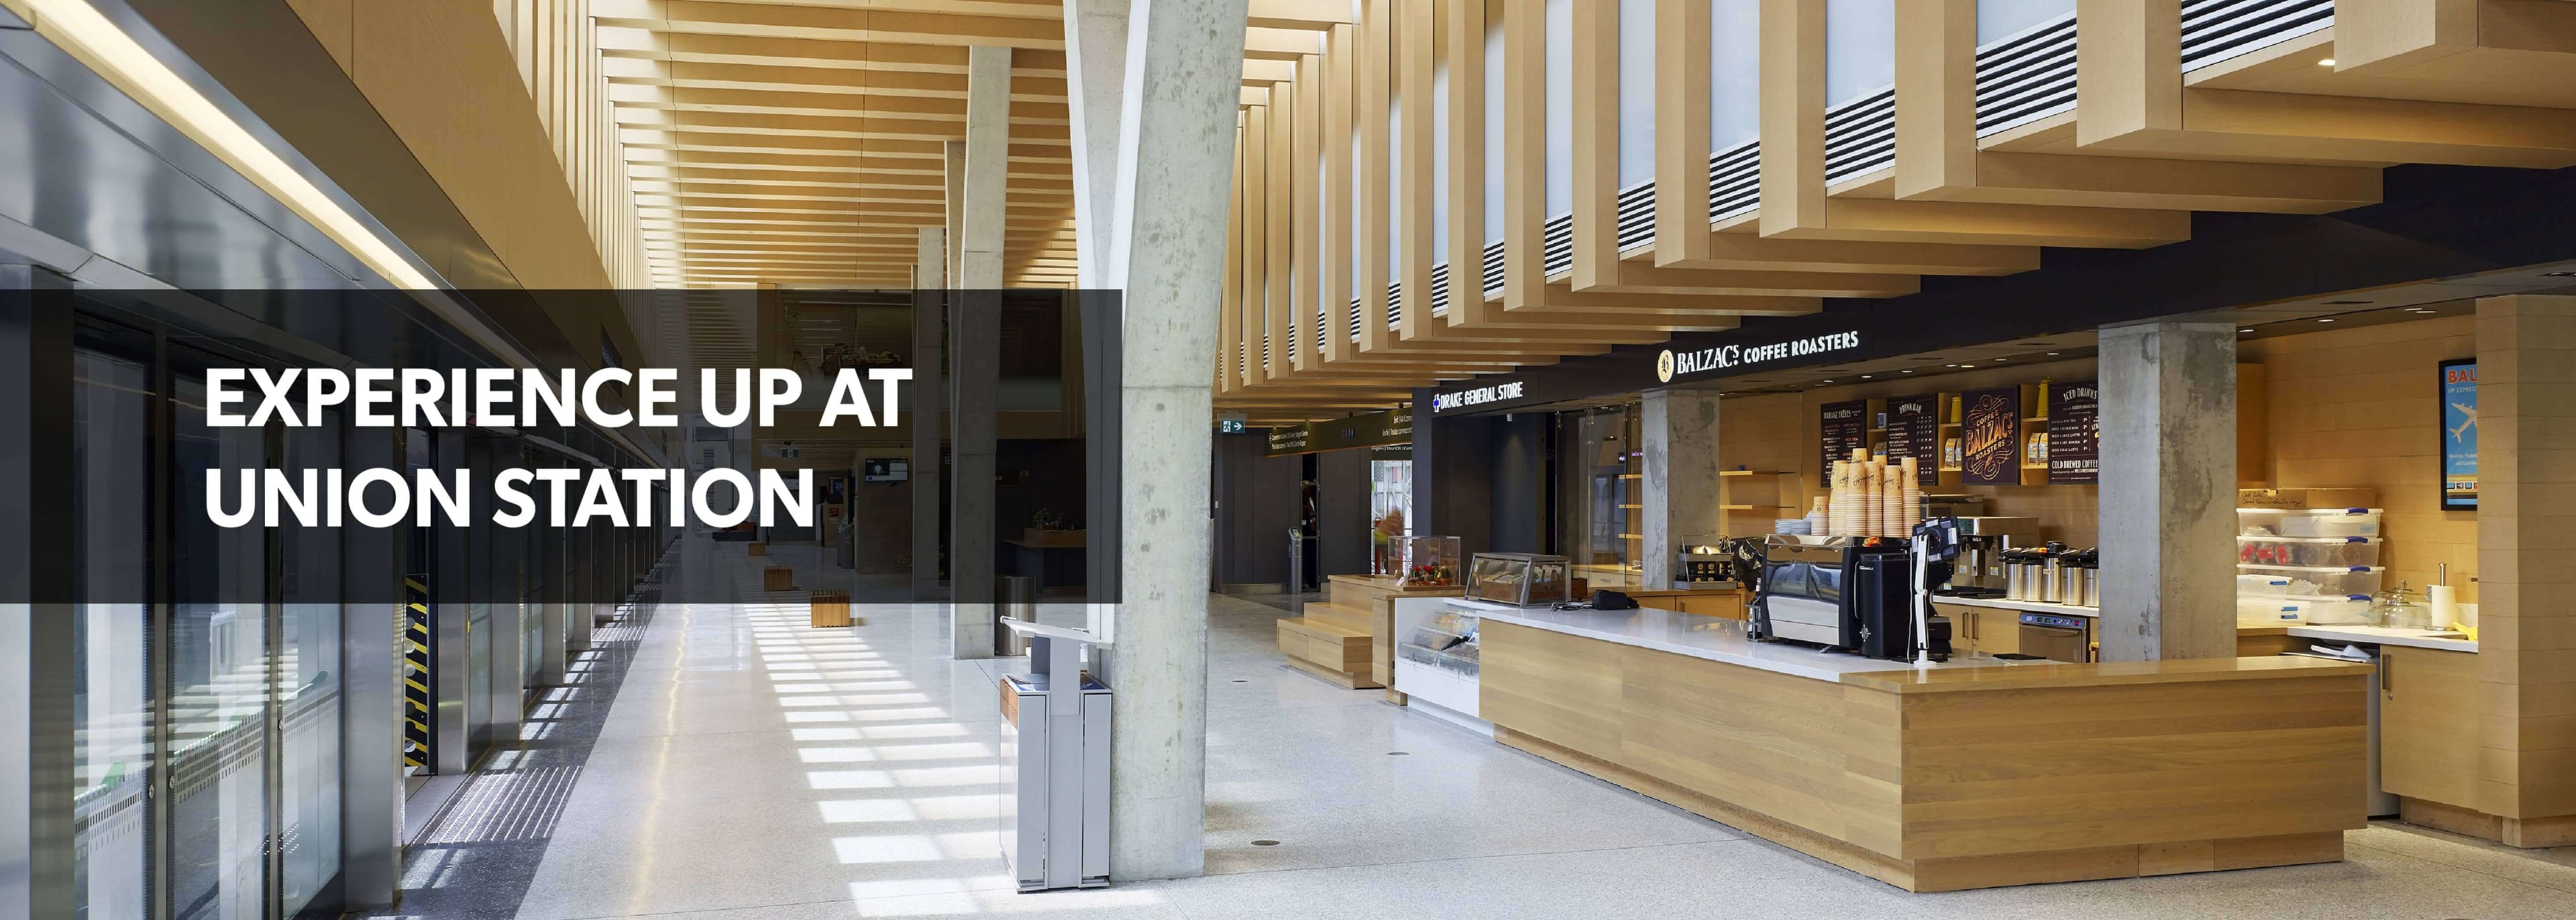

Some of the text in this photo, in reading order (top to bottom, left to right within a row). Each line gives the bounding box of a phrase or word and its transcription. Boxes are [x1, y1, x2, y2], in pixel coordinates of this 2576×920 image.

[1744, 342, 1788, 364] COFFEE
[1791, 331, 1859, 357] ROASTERS
[1440, 381, 1523, 410] DRAKE GENERAL STORE
[2063, 387, 2098, 402] ICED DRINKS
[1976, 409, 1999, 427] COFFEE
[1975, 440, 2006, 461] ROASTERS
[2051, 459, 2098, 469] COLD BREWED COFFEE
